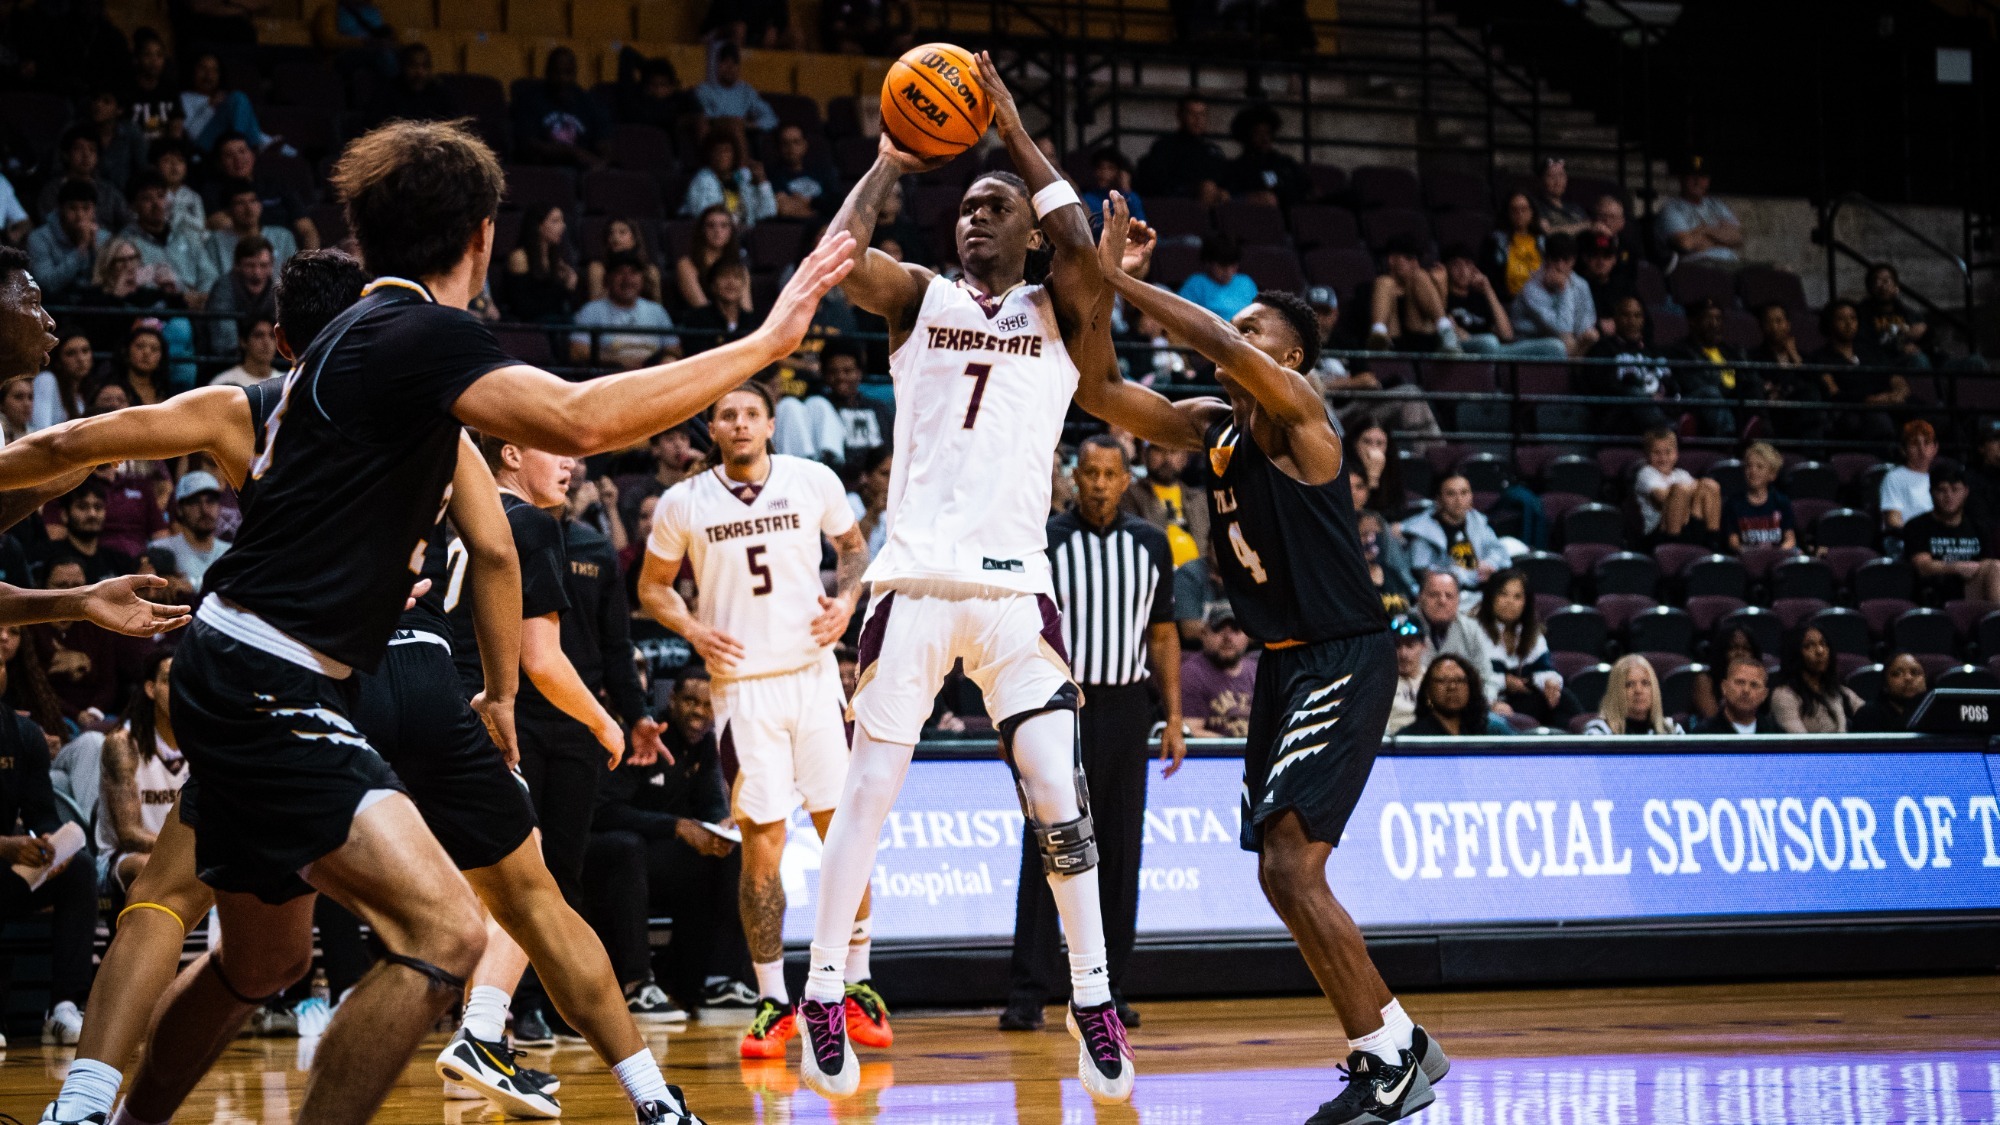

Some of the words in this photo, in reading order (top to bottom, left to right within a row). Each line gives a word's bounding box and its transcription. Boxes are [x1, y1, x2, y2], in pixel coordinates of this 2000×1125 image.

[920, 51, 978, 111] Wilson
[901, 82, 952, 128] NCAA
[927, 326, 985, 352] TEXAS
[984, 333, 1042, 358] STATE
[961, 361, 993, 431] 7
[705, 519, 754, 543] TEXAS
[754, 513, 800, 535] STATE
[570, 561, 599, 578] TXST
[746, 545, 773, 597] 5
[1228, 521, 1268, 584] 4
[1961, 705, 1989, 722] POSS
[0, 756, 14, 769] ST
[878, 809, 1025, 850] HRIST
[1380, 800, 1632, 881] OFFICIAL
[1643, 797, 1887, 875] SPONSOR
[1894, 796, 1956, 870] OF
